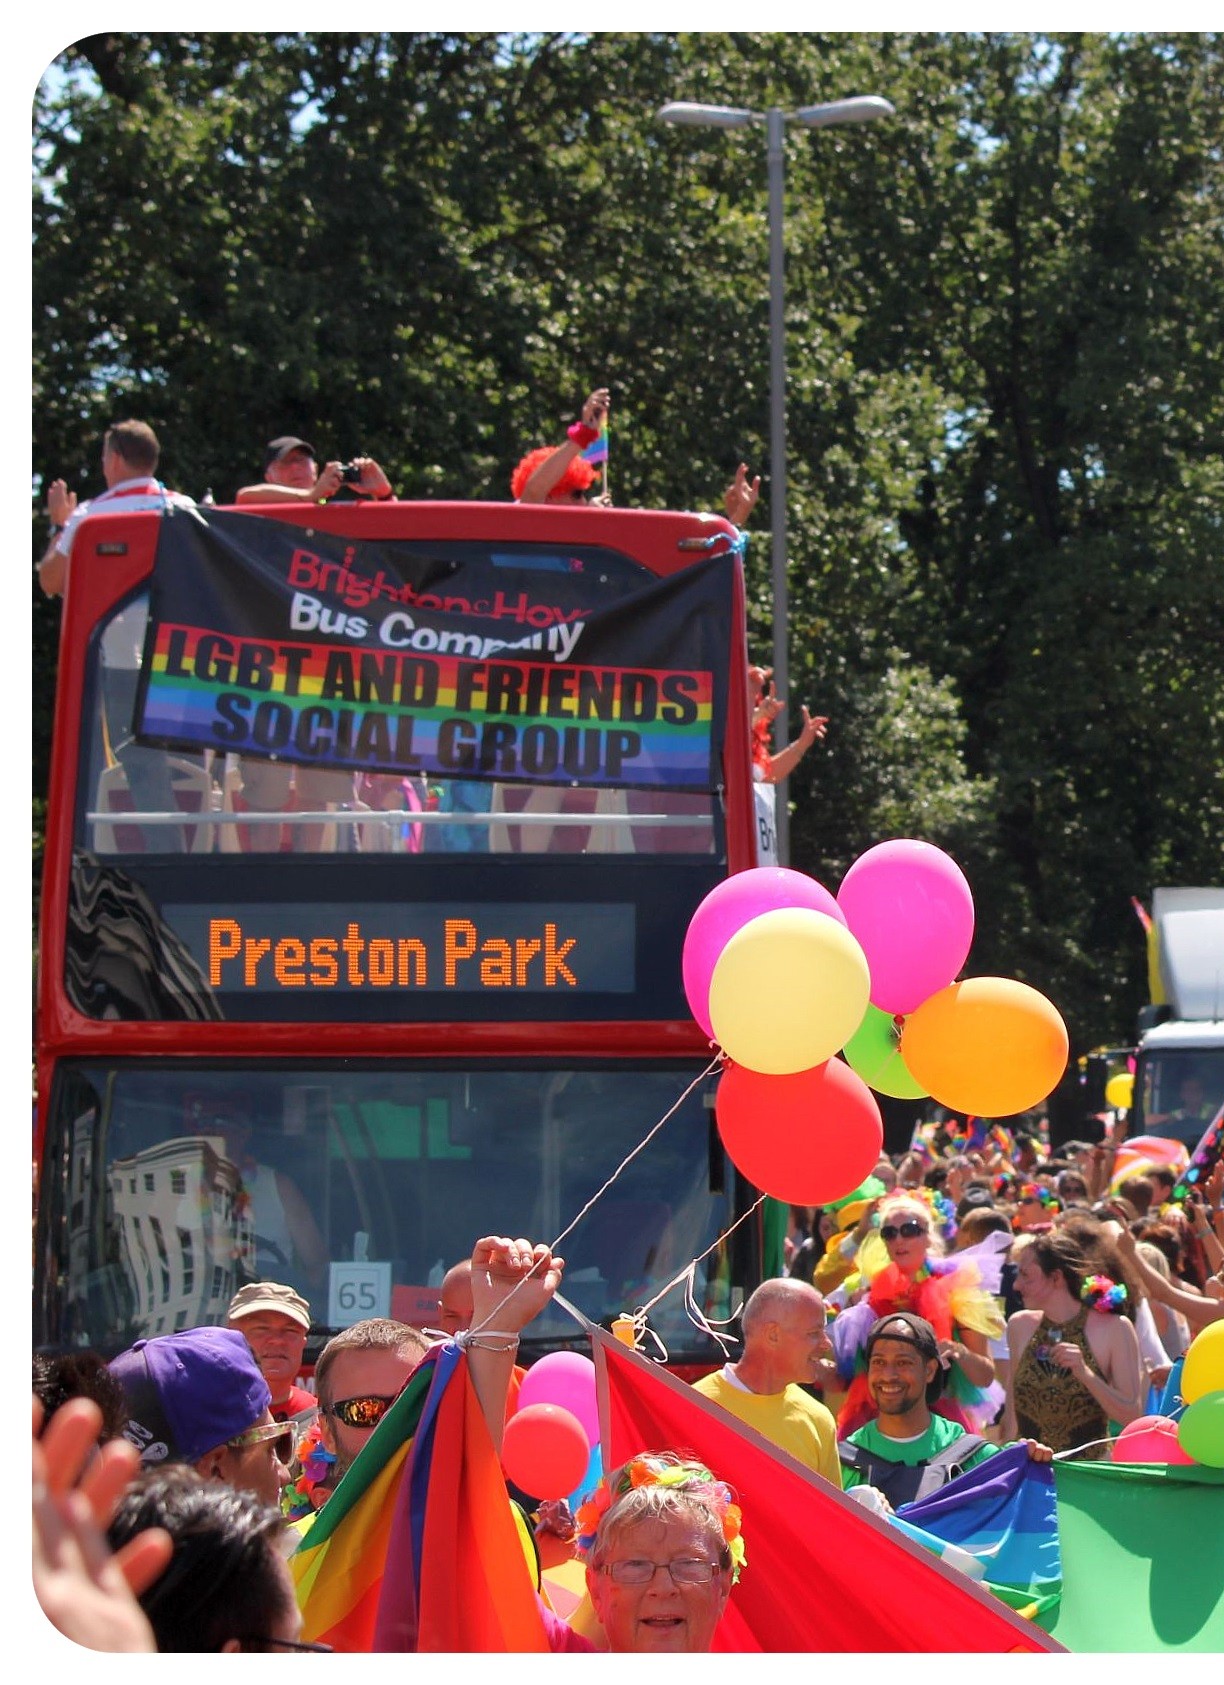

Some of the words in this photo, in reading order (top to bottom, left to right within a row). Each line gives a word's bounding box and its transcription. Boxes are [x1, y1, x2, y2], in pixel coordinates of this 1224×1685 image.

[290, 592, 368, 638] Bus
[164, 629, 313, 697] LGBT
[320, 651, 441, 708] AND
[454, 661, 699, 725] FRIENDS
[211, 692, 421, 765] SOCIAL
[437, 718, 641, 778] GROUP
[209, 919, 427, 987] Preston
[444, 919, 577, 987] Park
[338, 1282, 376, 1311] 65
